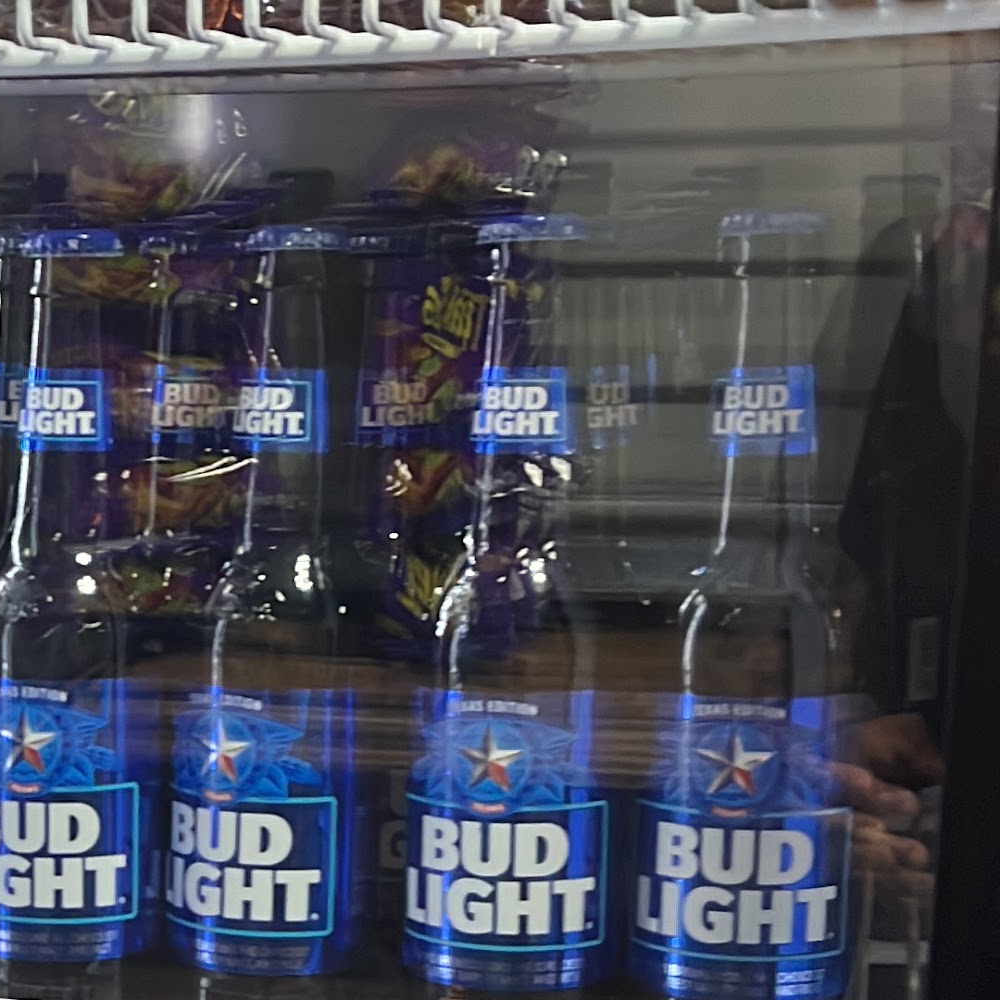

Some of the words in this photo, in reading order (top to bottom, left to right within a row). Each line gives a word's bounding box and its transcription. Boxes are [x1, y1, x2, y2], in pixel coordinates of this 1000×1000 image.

[26, 386, 84, 410] BUD
[163, 382, 221, 404] BUD
[240, 385, 295, 411] BUD
[373, 382, 427, 405] BUD
[485, 385, 548, 410] BUD
[723, 384, 789, 410] BUD
[18, 408, 96, 435] LIGHT
[233, 410, 304, 436] LIGHT
[473, 409, 560, 436] LIGHT
[587, 403, 641, 429] GHT
[712, 408, 805, 435] LIGHT
[170, 800, 293, 865] BUD
[421, 815, 569, 877] BUD
[656, 821, 814, 886] BUD
[406, 867, 596, 936] LIGHT
[637, 876, 837, 944] LIGHT
